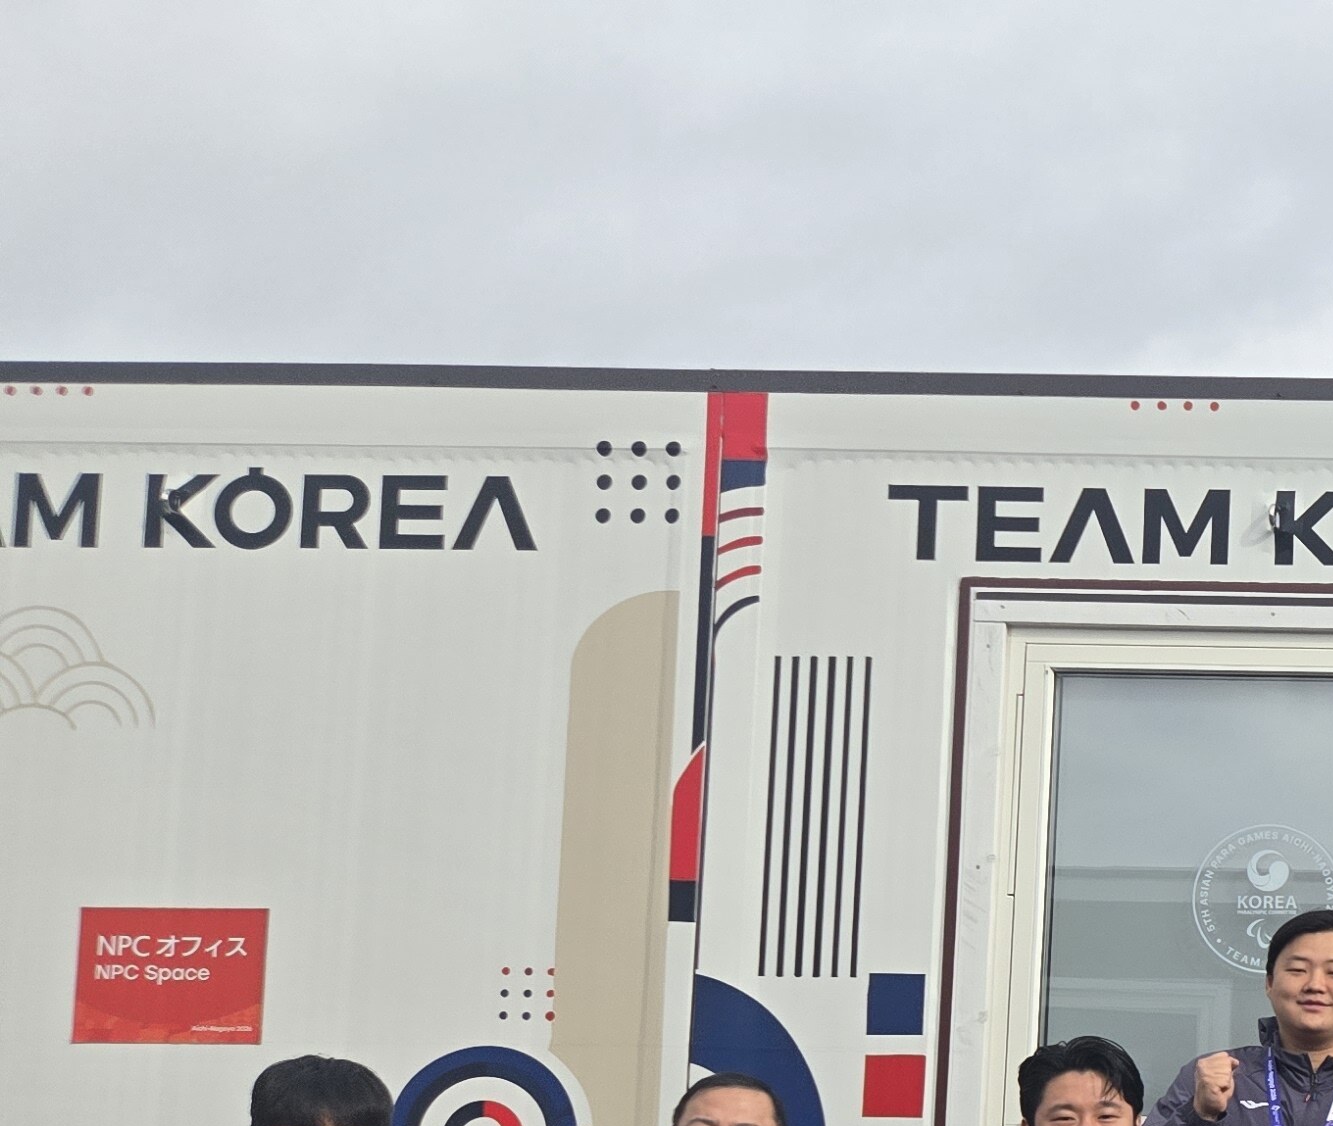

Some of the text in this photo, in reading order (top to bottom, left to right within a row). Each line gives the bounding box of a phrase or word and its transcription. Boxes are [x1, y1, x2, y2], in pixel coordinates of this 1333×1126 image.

[0, 467, 538, 551] M KOREA
[887, 484, 1232, 565] TEAM
[1200, 870, 1215, 906] ASIAN
[1210, 843, 1236, 869] PARA
[1238, 830, 1279, 845] GAMES
[1237, 895, 1297, 909] KOREA
[96, 934, 248, 958] NPC オフィス
[1225, 946, 1261, 966] TEAM
[94, 964, 210, 985] NPC Space
